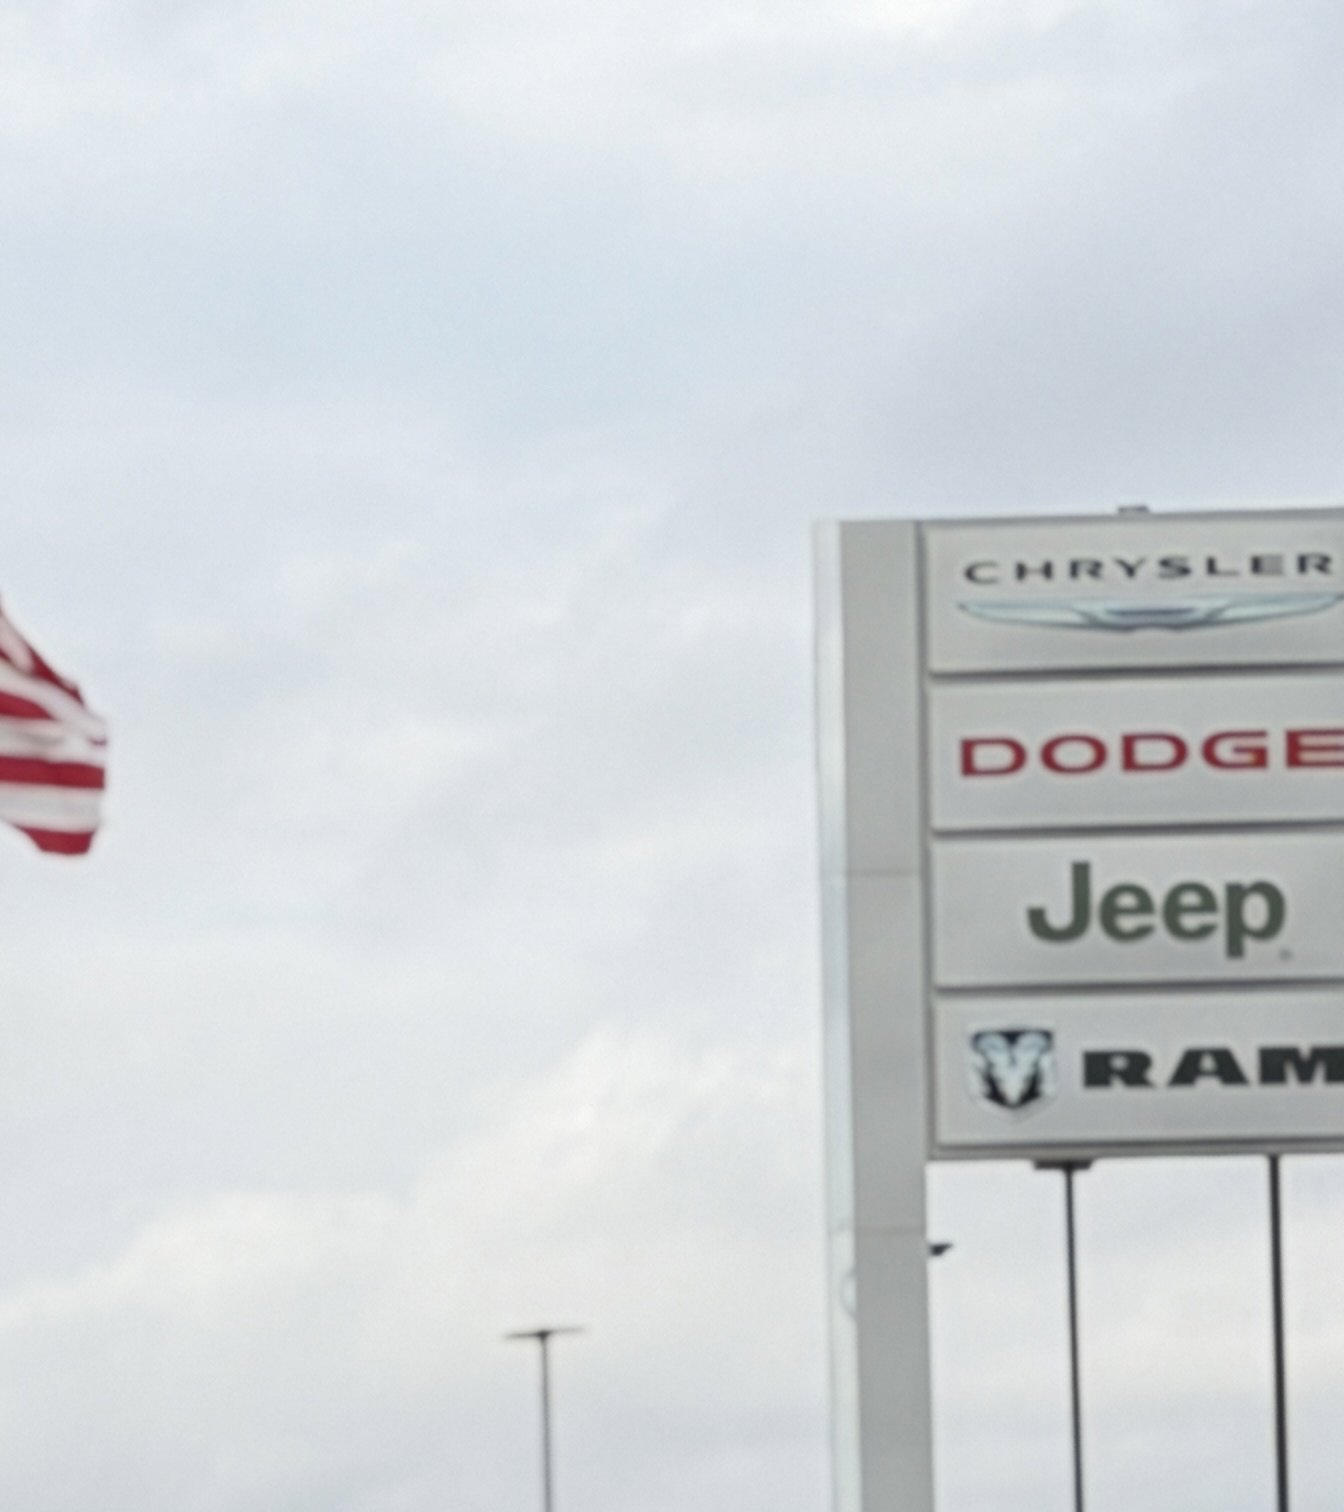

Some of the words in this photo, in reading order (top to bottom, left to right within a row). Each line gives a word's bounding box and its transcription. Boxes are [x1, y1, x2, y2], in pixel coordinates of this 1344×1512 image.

[964, 552, 1334, 585] CHRYSLER
[959, 729, 1344, 778] DODGE
[1027, 861, 1287, 961] Jeep
[1081, 1046, 1344, 1090] RAM
